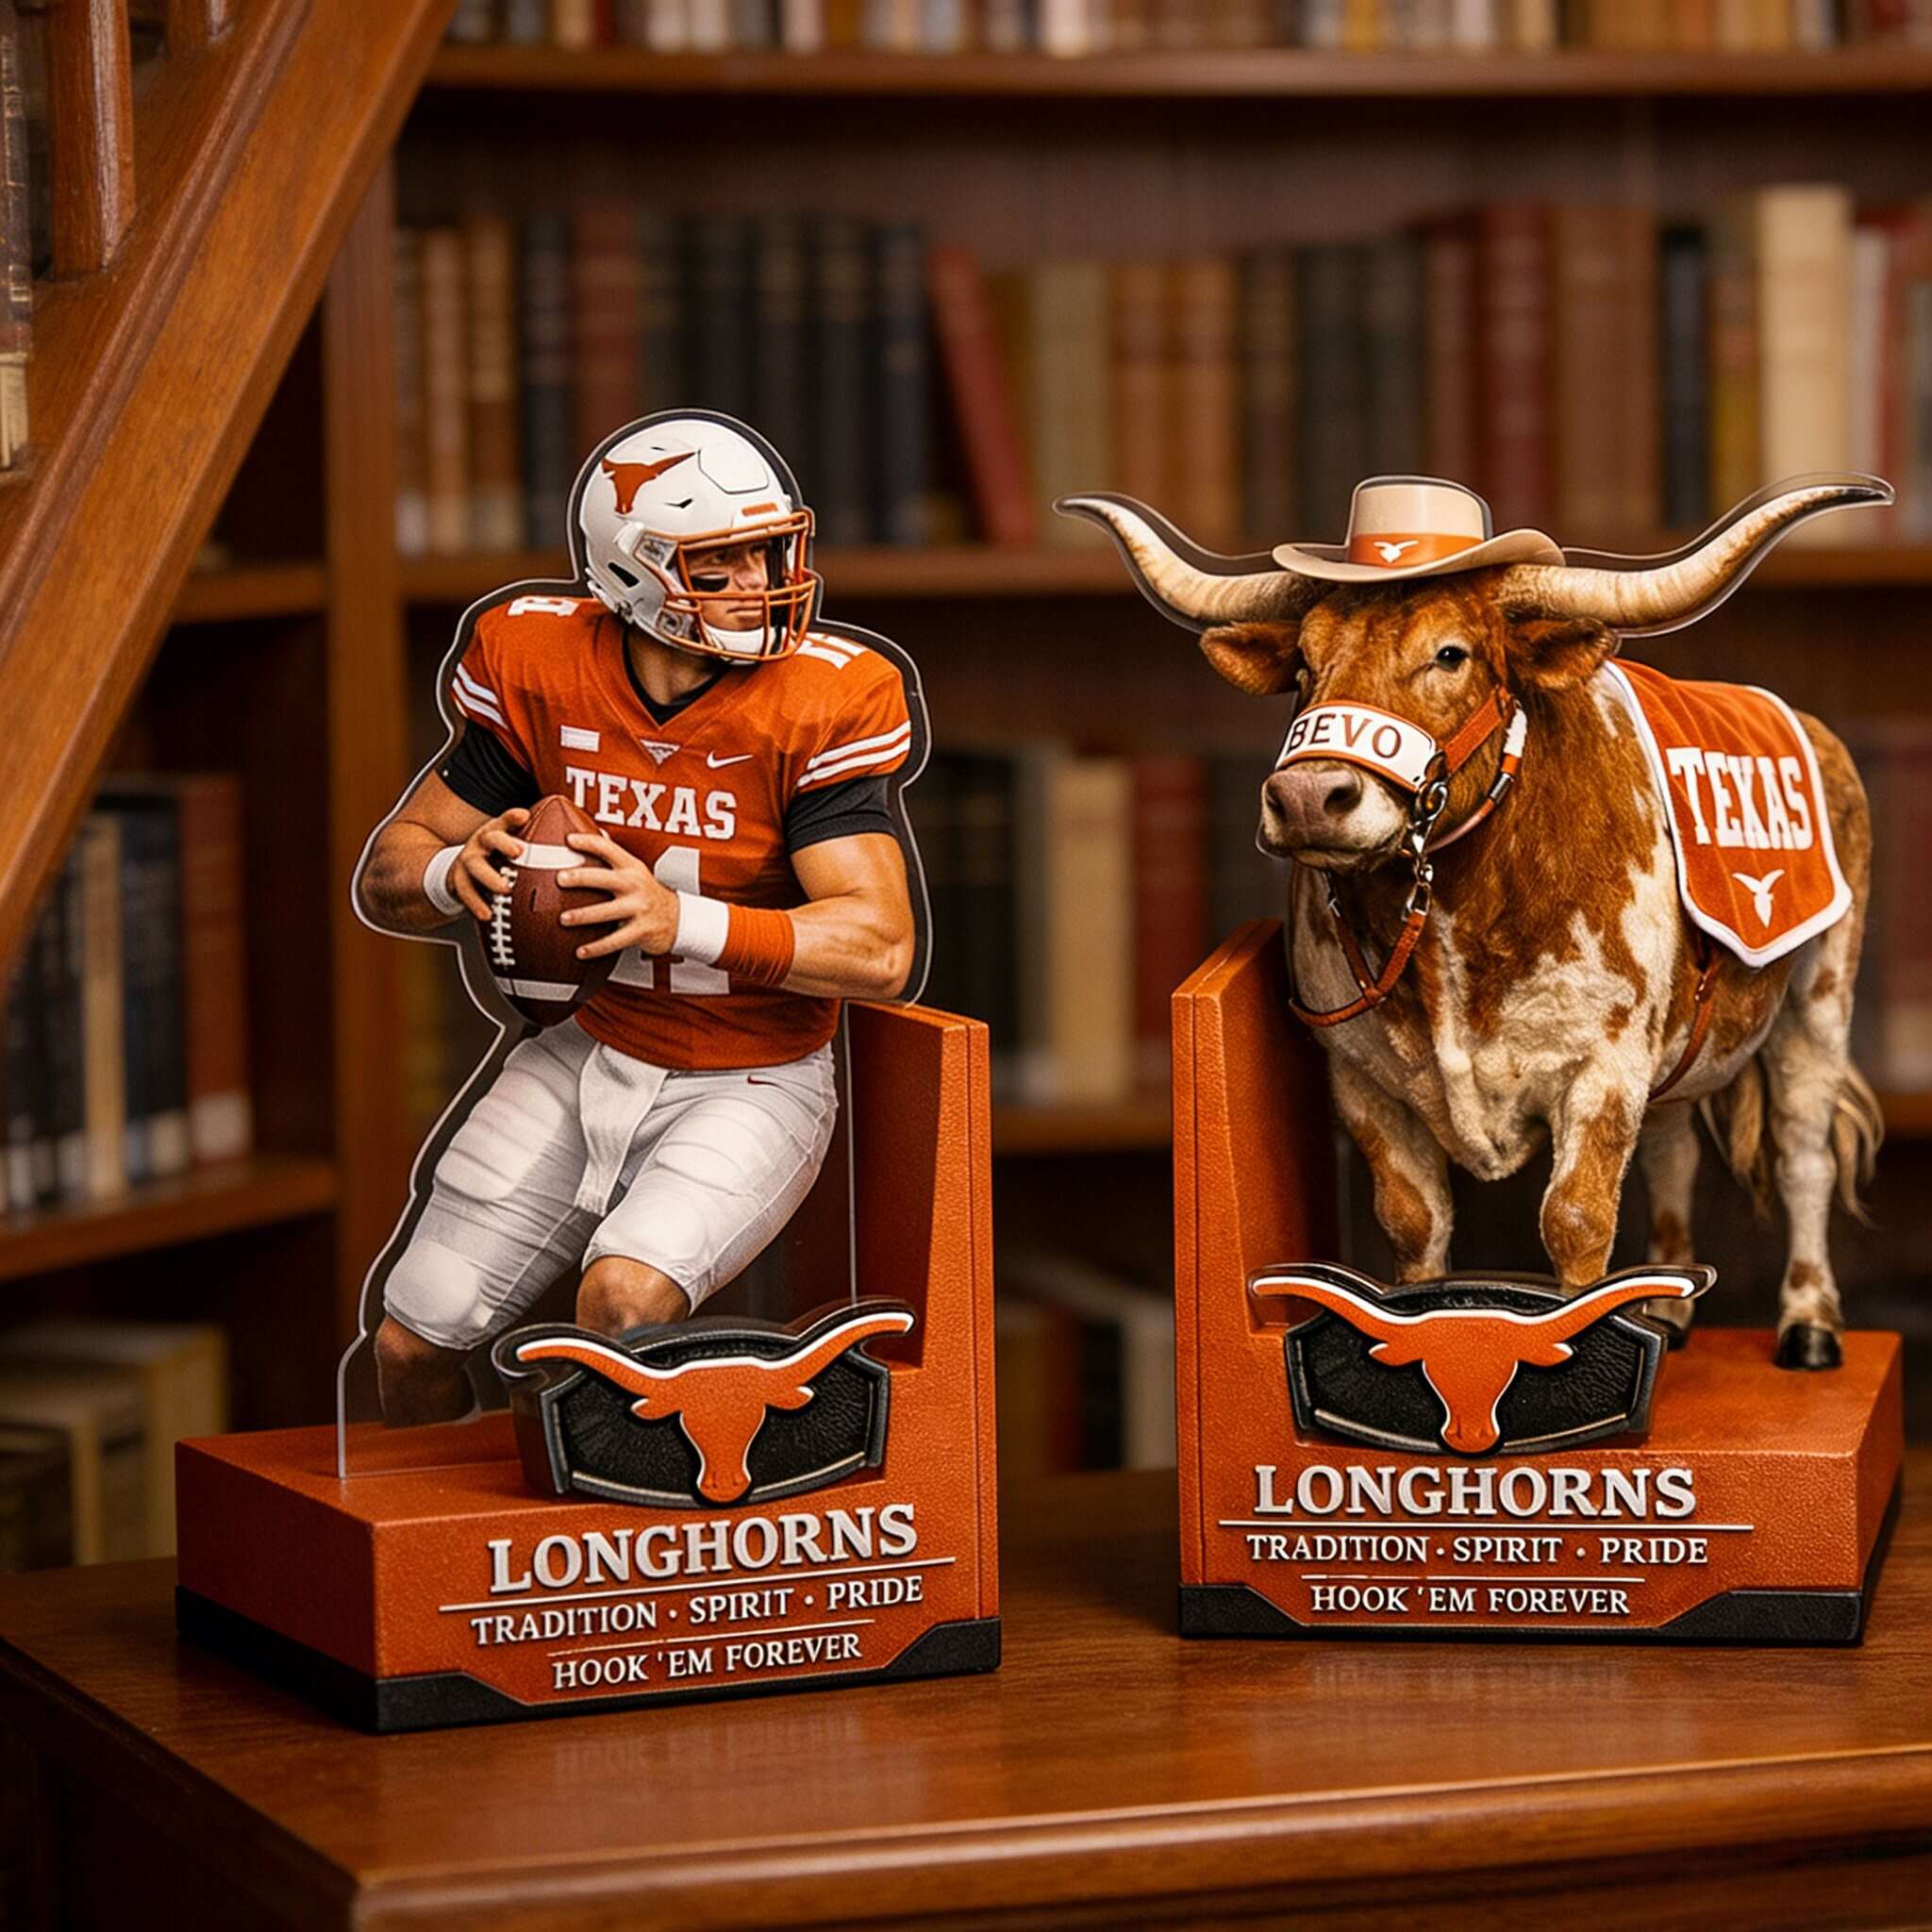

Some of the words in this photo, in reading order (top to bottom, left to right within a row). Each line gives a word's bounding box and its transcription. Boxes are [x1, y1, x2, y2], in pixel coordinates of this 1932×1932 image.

[1286, 714, 1402, 758] BEVO
[566, 766, 738, 841] TEXAS
[1666, 748, 1813, 849] TEXAS
[1254, 1465, 1696, 1518] LONGHORNS
[488, 1503, 917, 1593] LONGHORNS
[1247, 1535, 1429, 1562] TRADITION
[1453, 1538, 1562, 1563] SPIRIT
[1600, 1538, 1708, 1564] PRIDE
[471, 1602, 658, 1645] TRADITION
[690, 1589, 794, 1624] SPIRIT
[827, 1574, 923, 1610] PRIDE
[1310, 1586, 1409, 1612] HOOK
[1418, 1587, 1475, 1613] 'EM
[1489, 1589, 1631, 1614] FOREVER
[553, 1655, 649, 1690] HOOK
[658, 1648, 713, 1677] 'EM
[726, 1633, 862, 1670] FOREVER
